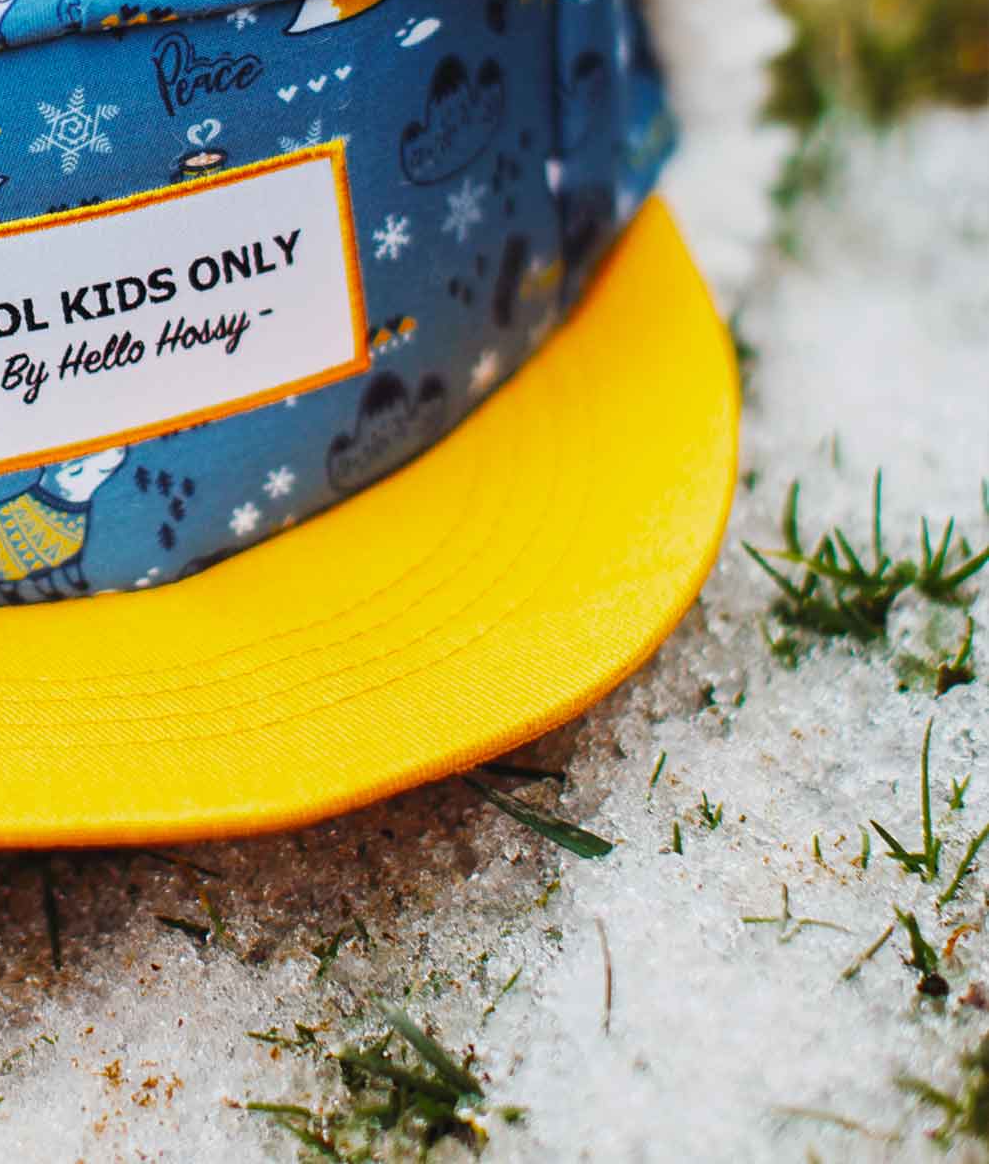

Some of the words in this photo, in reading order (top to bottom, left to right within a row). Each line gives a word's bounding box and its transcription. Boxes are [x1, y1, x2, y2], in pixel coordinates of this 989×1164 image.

[152, 32, 265, 116] Peace
[61, 267, 177, 324] KIDS
[188, 229, 301, 291] ONLY
[1, 353, 48, 404] By
[59, 332, 146, 379] Hello
[156, 309, 250, 354] Hossy
